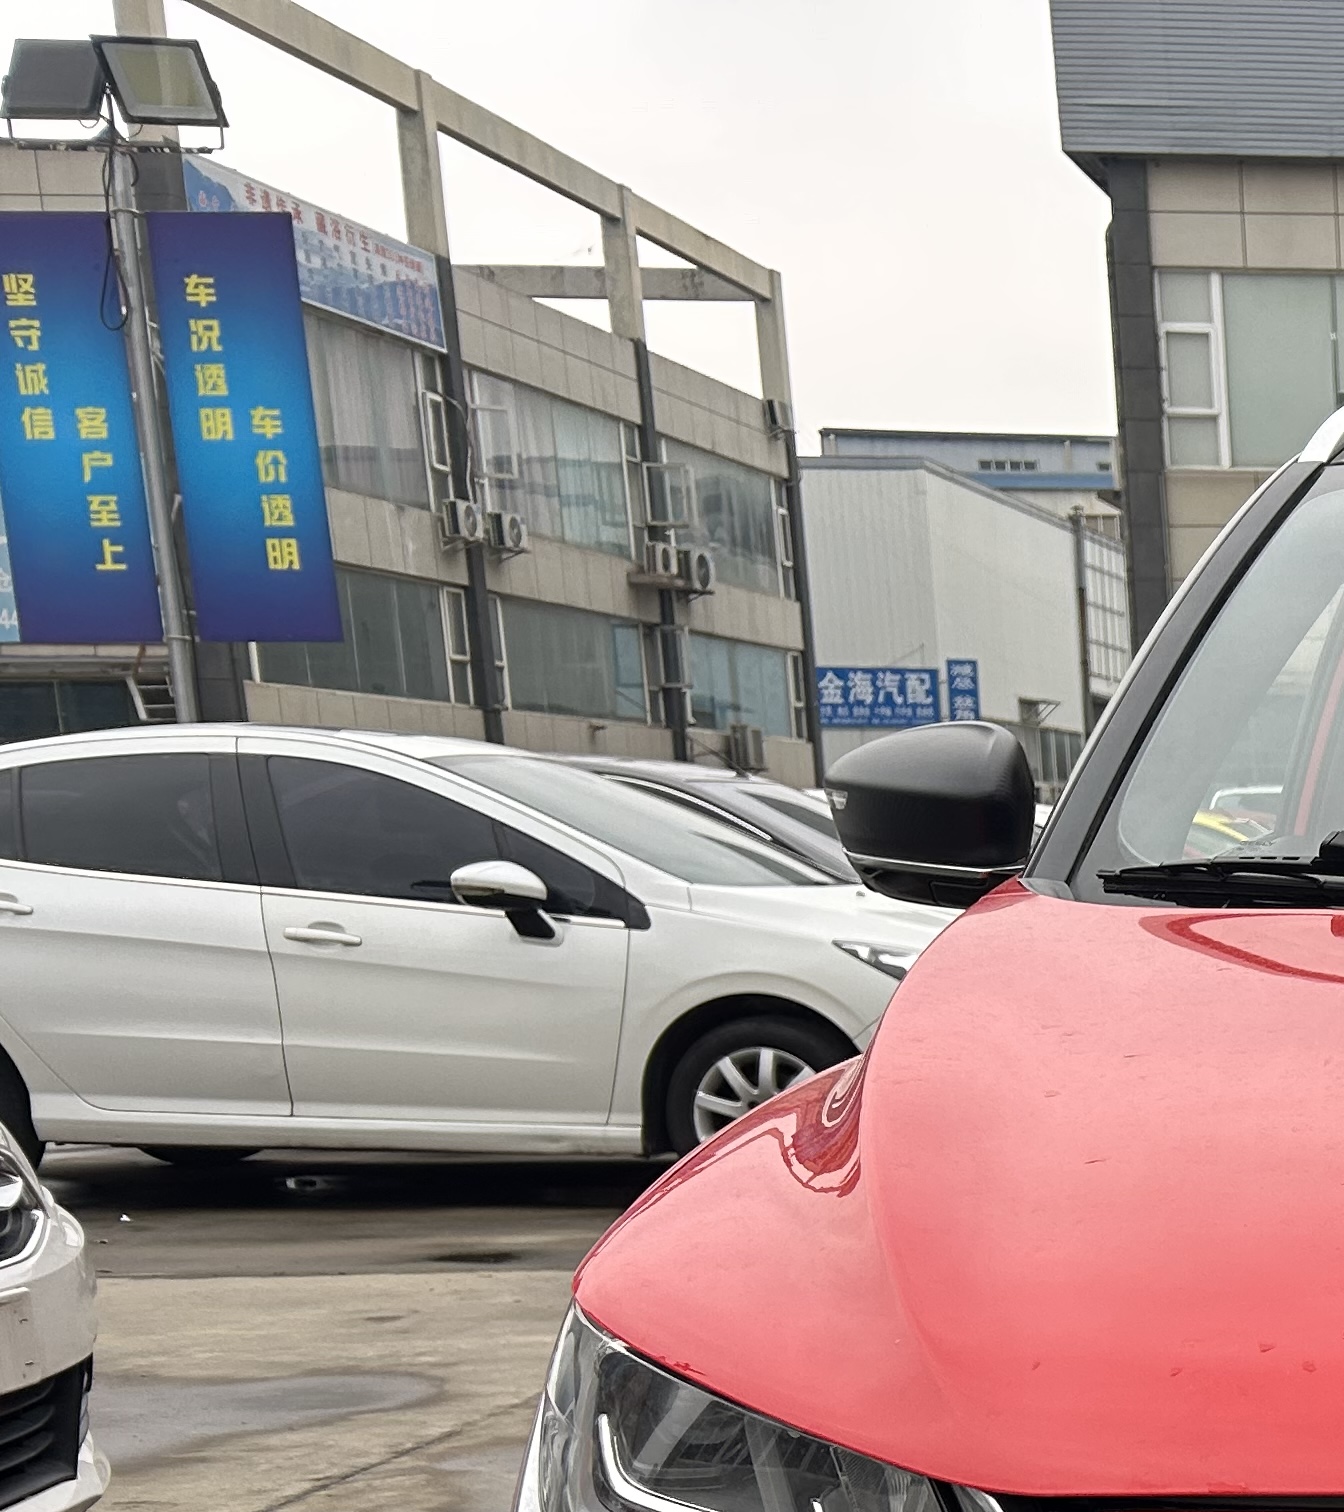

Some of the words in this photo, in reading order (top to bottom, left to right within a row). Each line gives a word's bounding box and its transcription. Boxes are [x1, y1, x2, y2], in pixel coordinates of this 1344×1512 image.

[2, 273, 55, 440] 坚守诚信
[184, 273, 235, 441] 车况透明
[75, 406, 127, 571] 客户至上
[250, 406, 301, 571] 车价透明
[818, 670, 933, 705] 金海汽配
